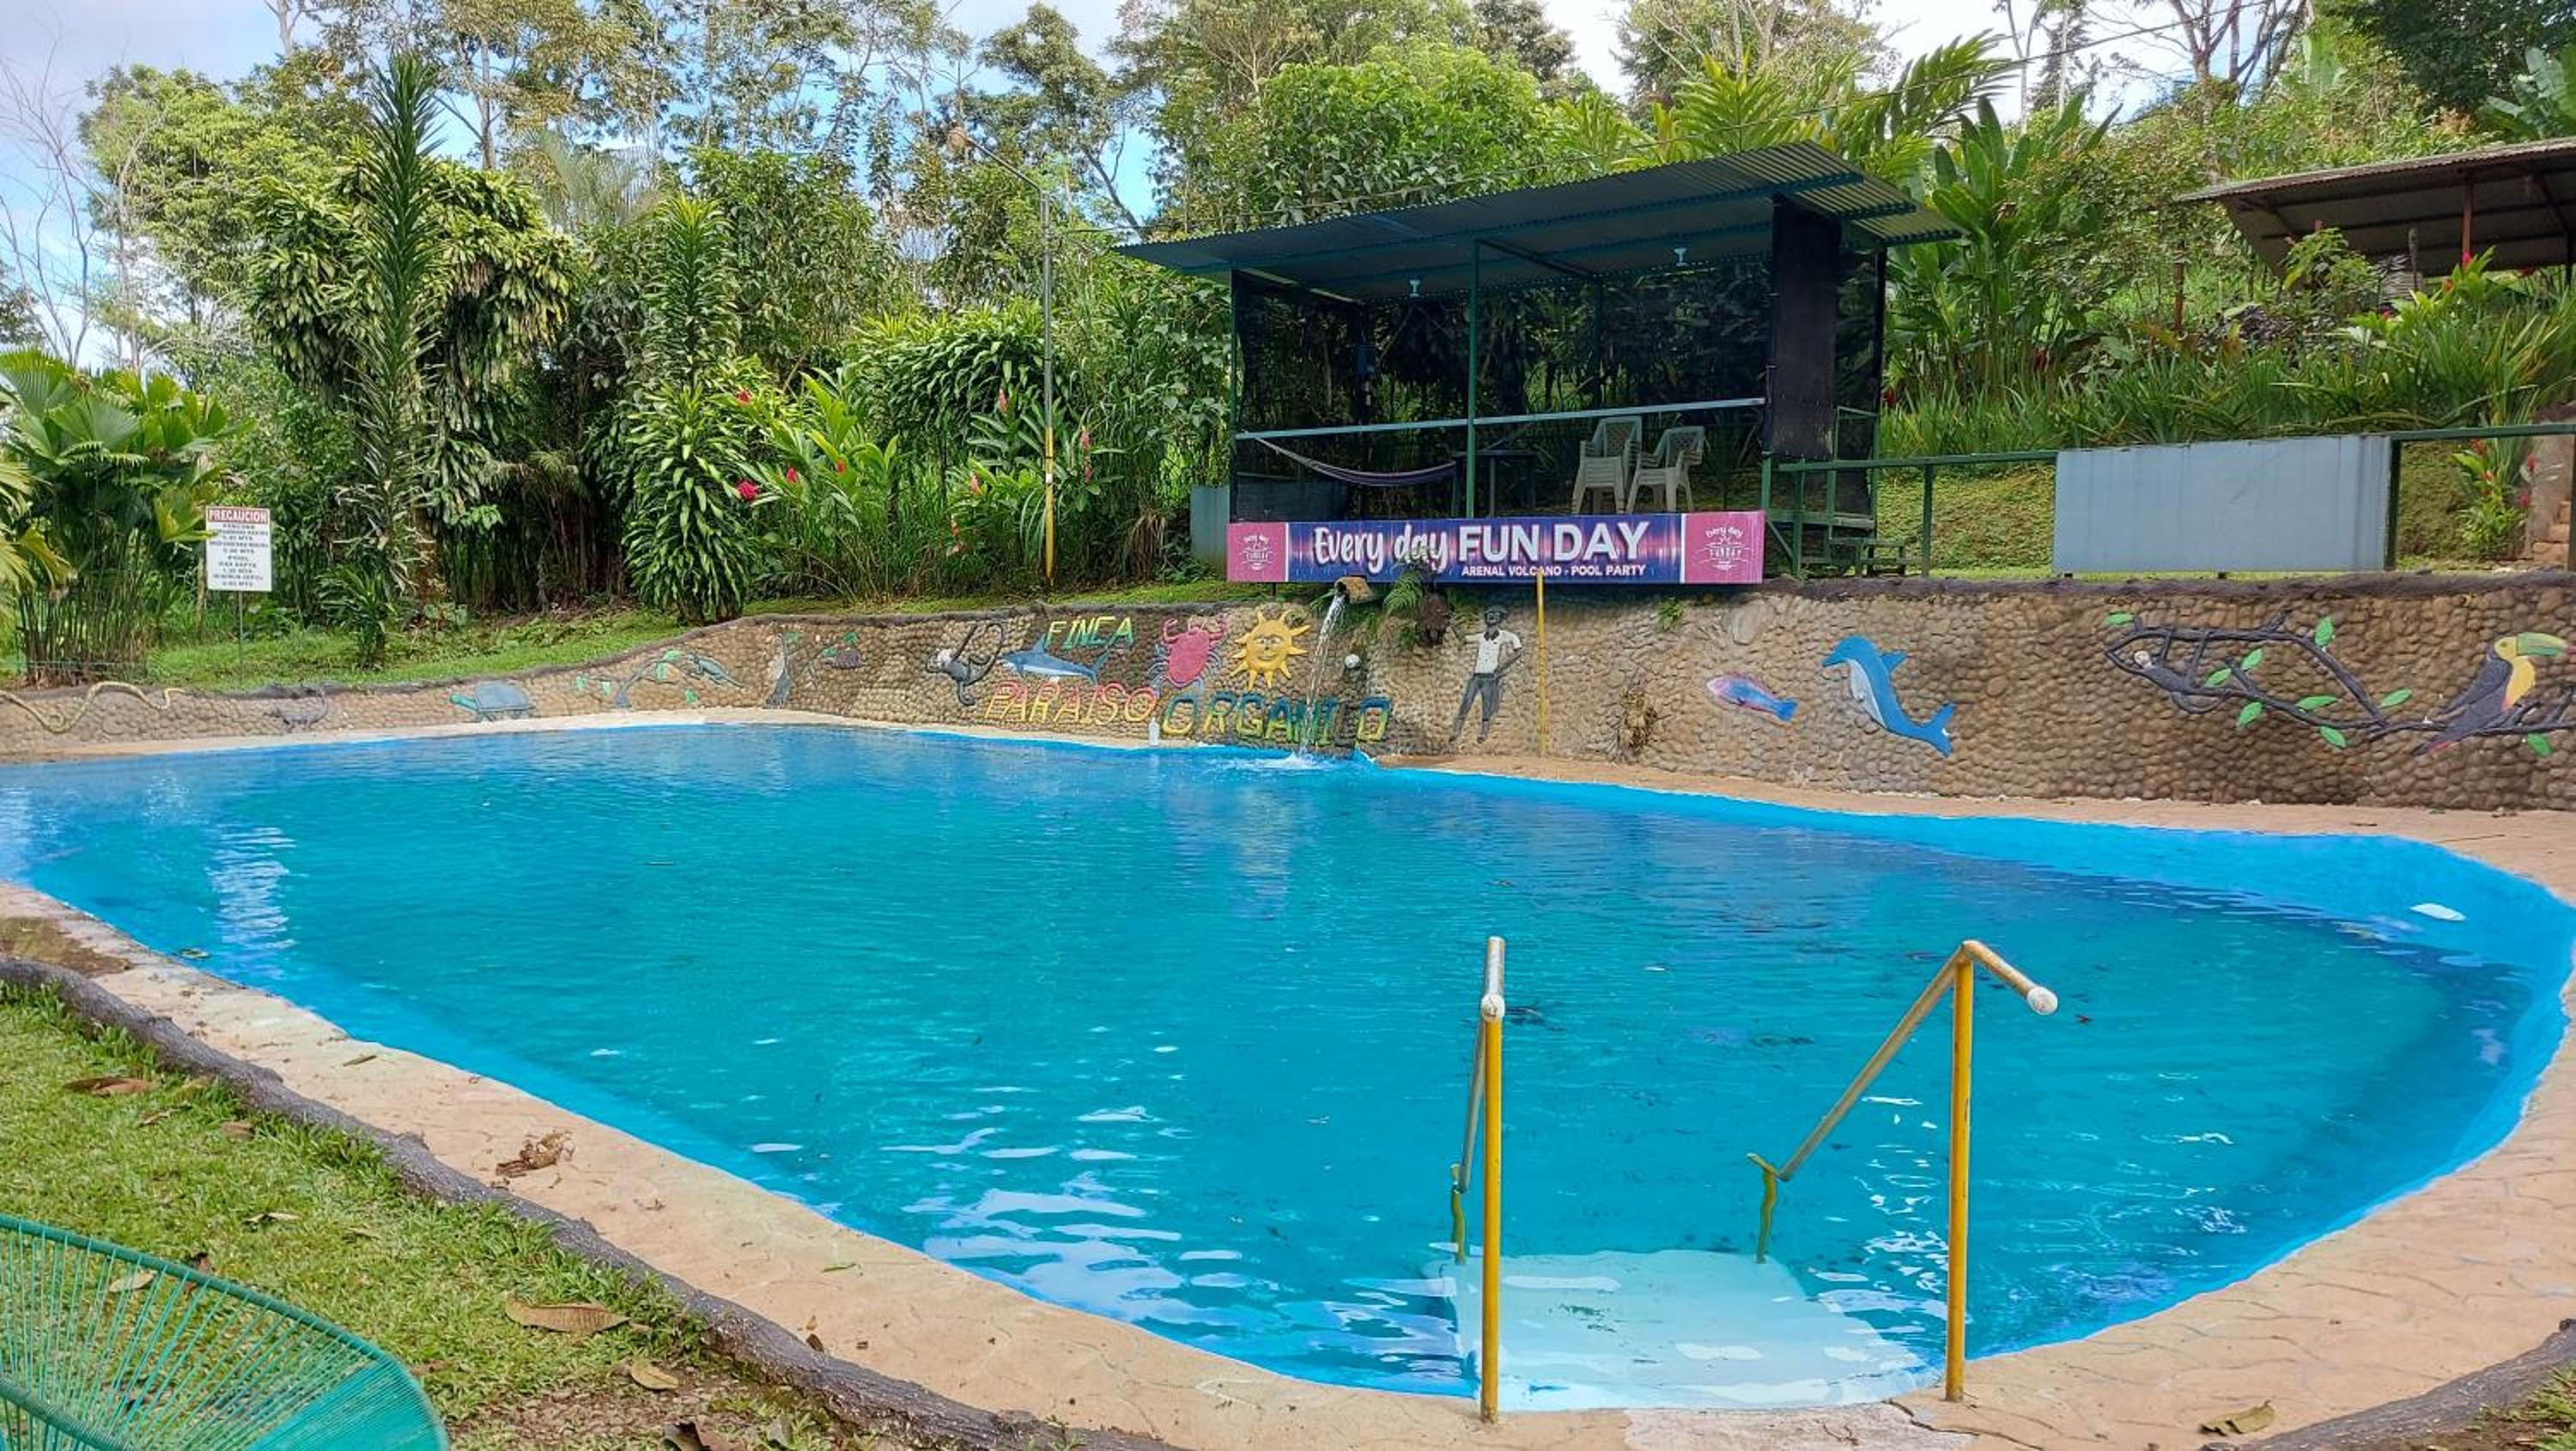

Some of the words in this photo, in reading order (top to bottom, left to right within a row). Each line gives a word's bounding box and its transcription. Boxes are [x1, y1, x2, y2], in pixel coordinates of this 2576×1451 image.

[210, 509, 267, 522] PRECAUCION
[1314, 526, 1383, 574] Every
[1394, 523, 1449, 574] day
[1459, 524, 1540, 562] FUN
[1553, 521, 1649, 561] DAY
[1461, 565, 1504, 576] ARENAL
[1571, 565, 1603, 576] POOL
[1606, 564, 1647, 576] PARTY
[1044, 615, 1134, 652] FINCA
[985, 681, 1157, 726] PARAISO
